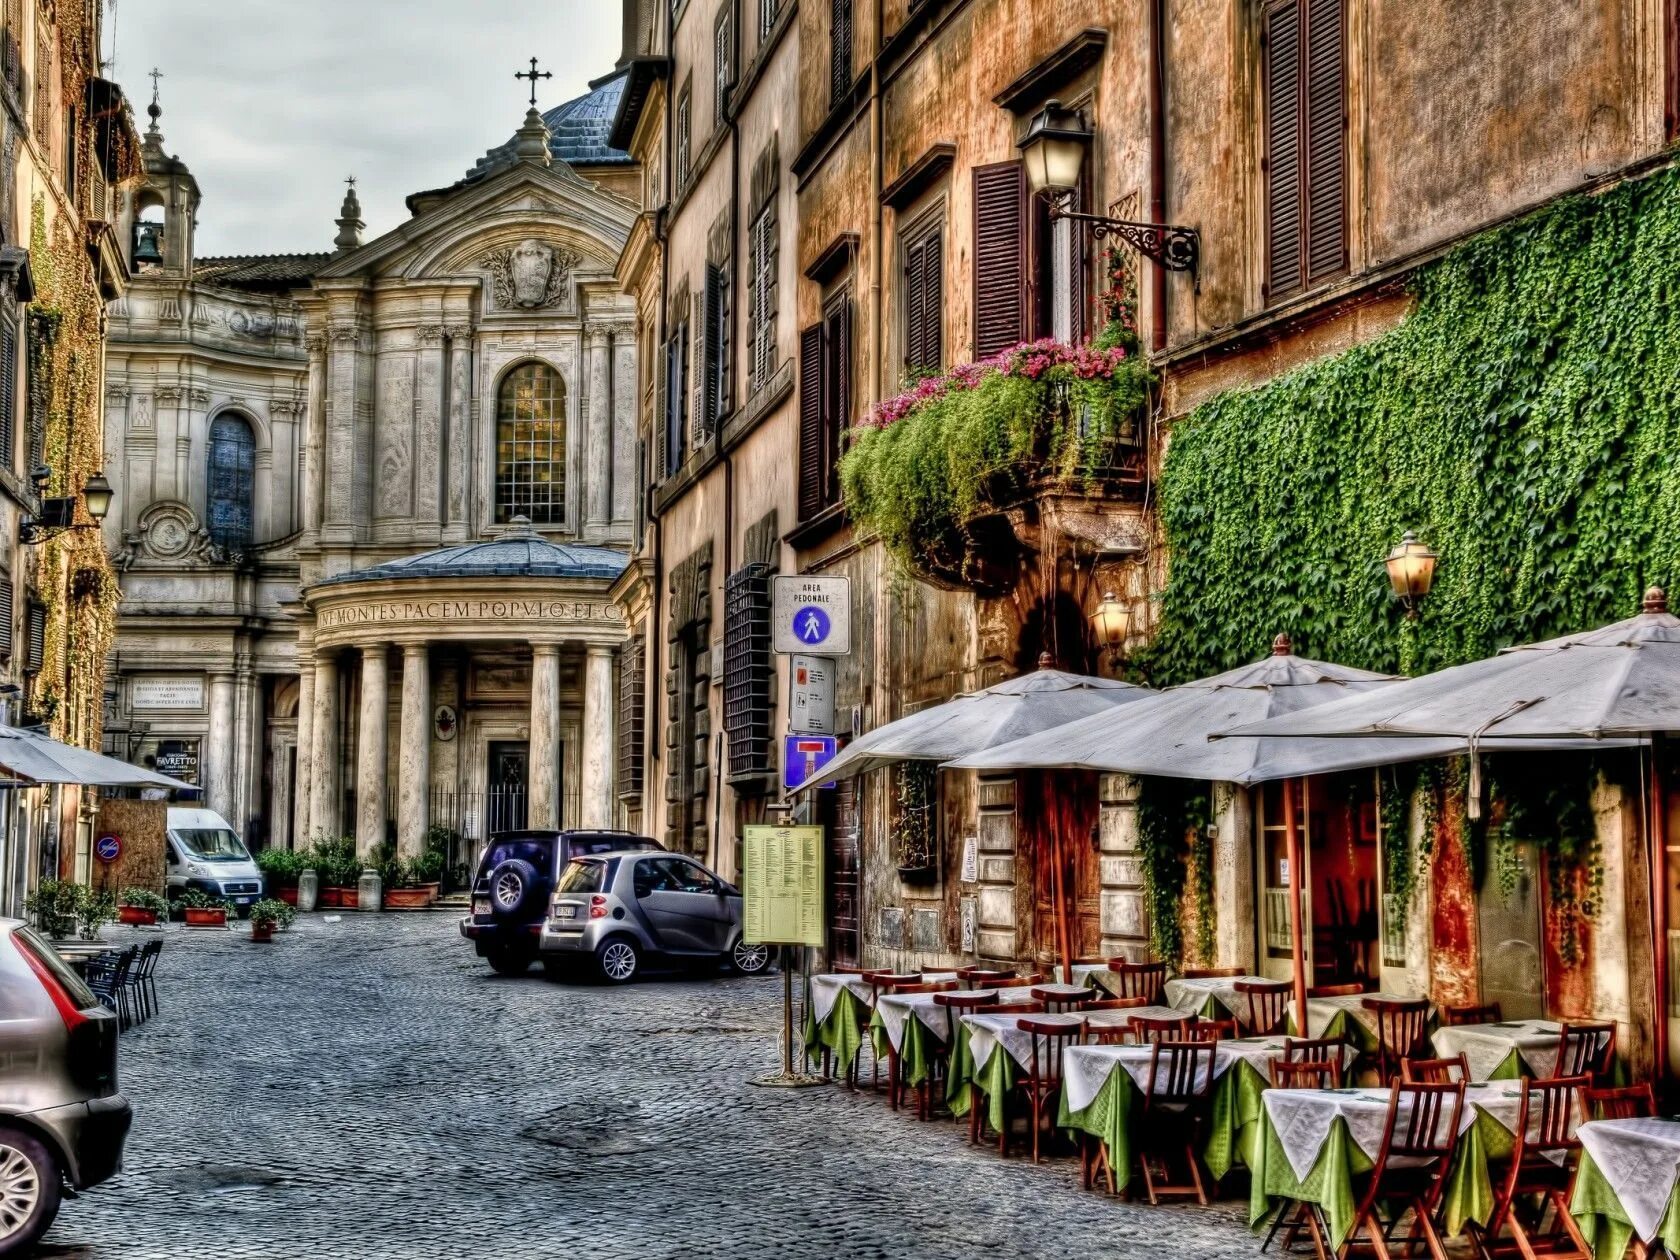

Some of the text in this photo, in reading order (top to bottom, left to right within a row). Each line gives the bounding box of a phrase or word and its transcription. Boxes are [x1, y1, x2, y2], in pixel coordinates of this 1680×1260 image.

[803, 584, 821, 592] AREA
[794, 594, 829, 603] PEDONALE
[337, 604, 396, 623] MONTES
[404, 602, 470, 618] PACEM
[478, 601, 565, 617] POPVLO
[574, 603, 594, 618] ET
[156, 757, 197, 766] FAVRETTO
